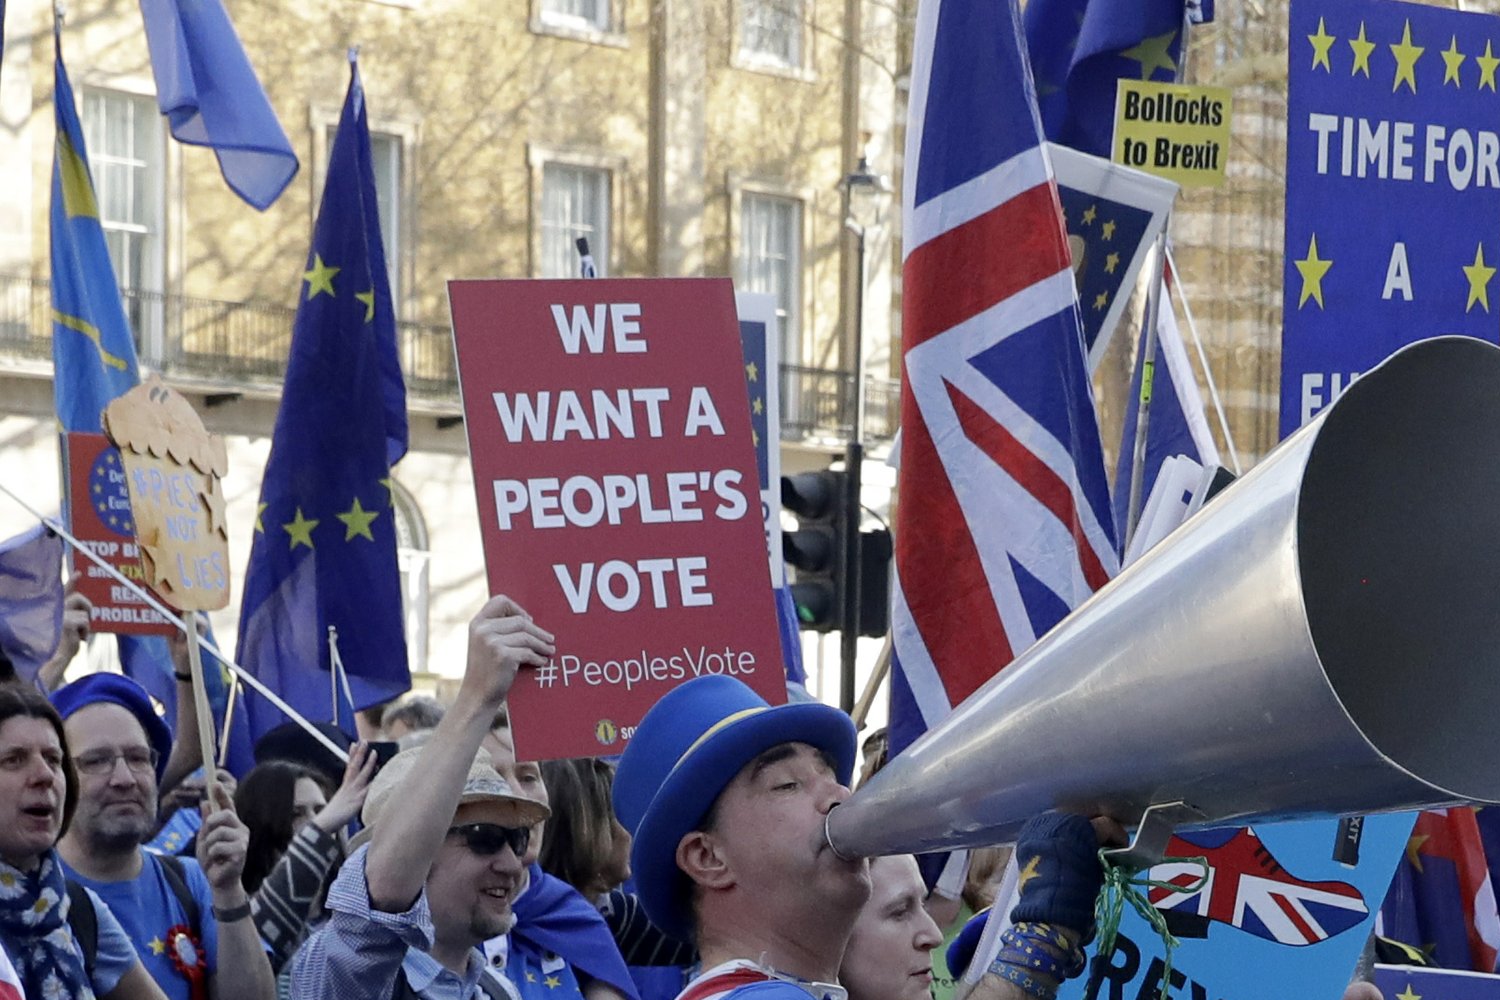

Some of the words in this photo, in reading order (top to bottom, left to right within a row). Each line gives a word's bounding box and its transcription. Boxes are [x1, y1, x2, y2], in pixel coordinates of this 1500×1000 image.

[1125, 90, 1223, 126] Bollocks
[1123, 138, 1147, 166] to
[1154, 137, 1219, 170] Brexit
[1309, 112, 1414, 181] TIME
[1424, 123, 1500, 191] FOR
[1381, 242, 1414, 301] A
[550, 303, 648, 354] WE
[492, 387, 670, 443] WANT
[684, 387, 726, 437] A
[493, 469, 748, 531] PEOPLE'S
[176, 551, 227, 590] LIES
[552, 556, 714, 614] VOTE
[534, 646, 756, 691] #PeoplesVote
[1348, 817, 1361, 844] XIT
